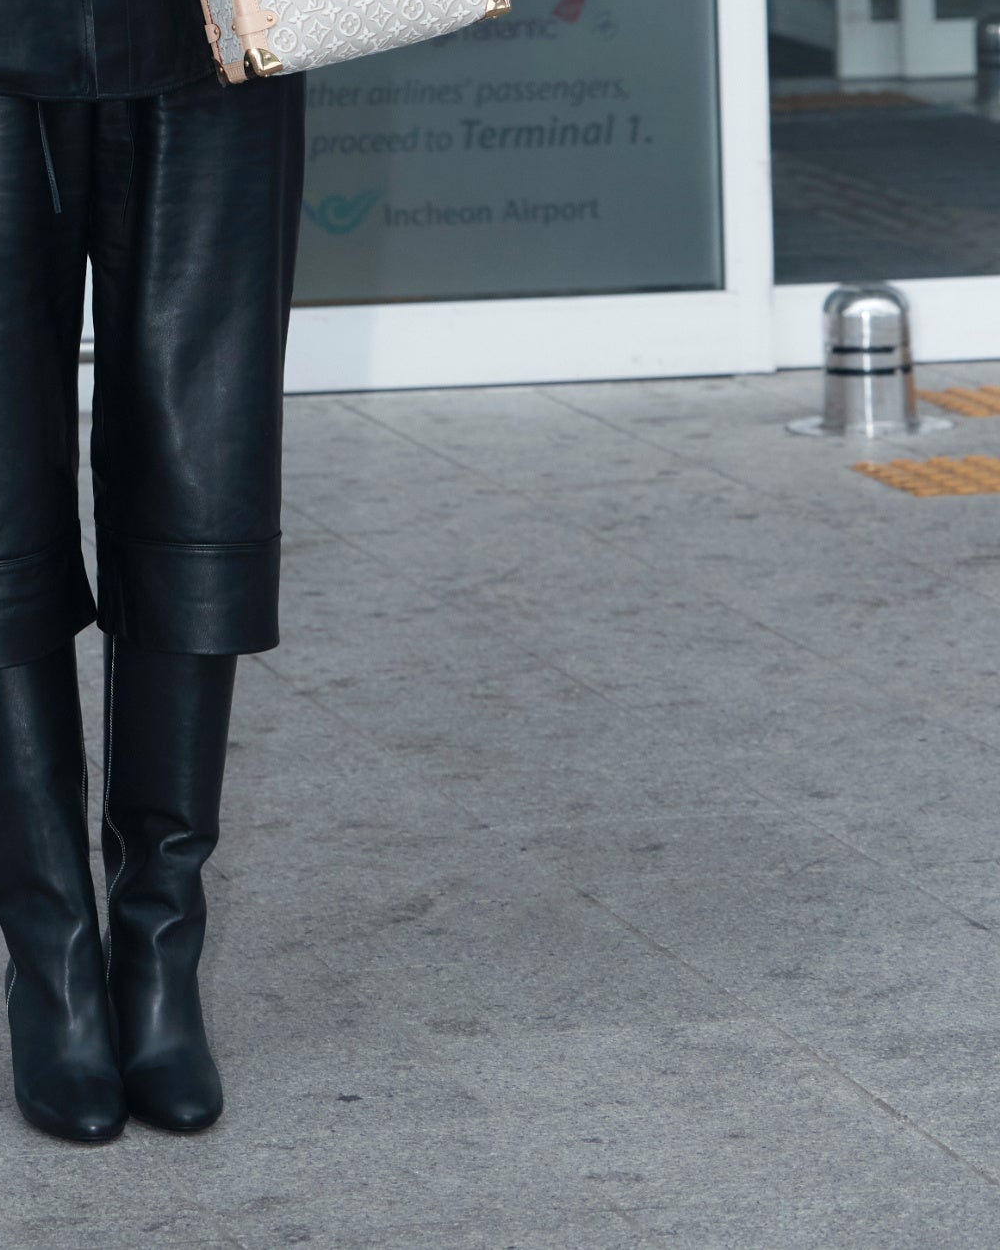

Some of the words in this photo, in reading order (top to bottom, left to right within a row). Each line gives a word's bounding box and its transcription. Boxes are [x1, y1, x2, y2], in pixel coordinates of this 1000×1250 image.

[307, 80, 361, 108] ther
[310, 126, 420, 162] proceed
[425, 128, 453, 150] to
[459, 117, 613, 150] Terminal
[384, 202, 492, 227] Incheon
[501, 199, 600, 226] Airport
